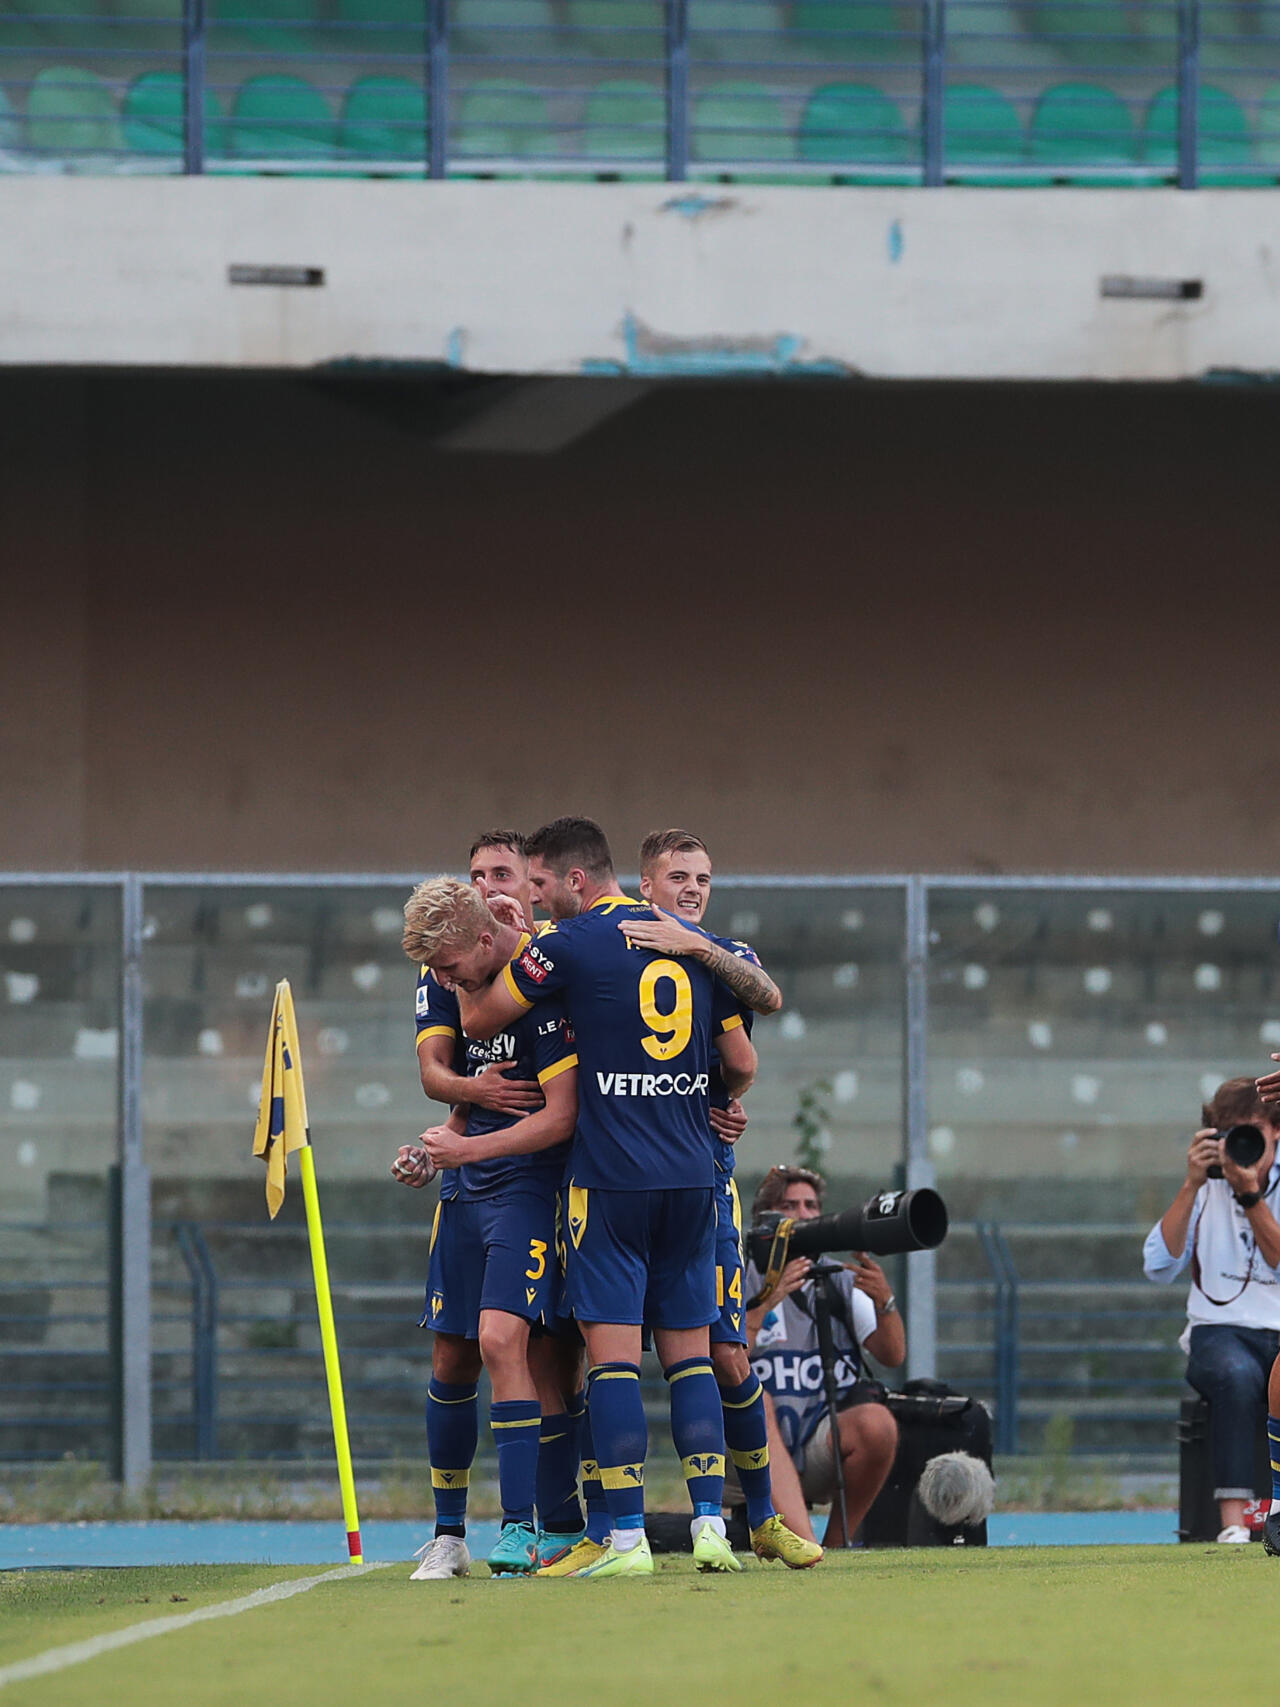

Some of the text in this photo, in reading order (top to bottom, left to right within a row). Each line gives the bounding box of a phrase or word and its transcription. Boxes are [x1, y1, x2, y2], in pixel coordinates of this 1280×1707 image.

[521, 955, 544, 979] RENT
[638, 958, 693, 1061] 9
[596, 1071, 709, 1097] VETROCAR
[525, 1238, 548, 1280] 3
[715, 1265, 743, 1308] 14
[751, 1355, 858, 1392] PHOO
